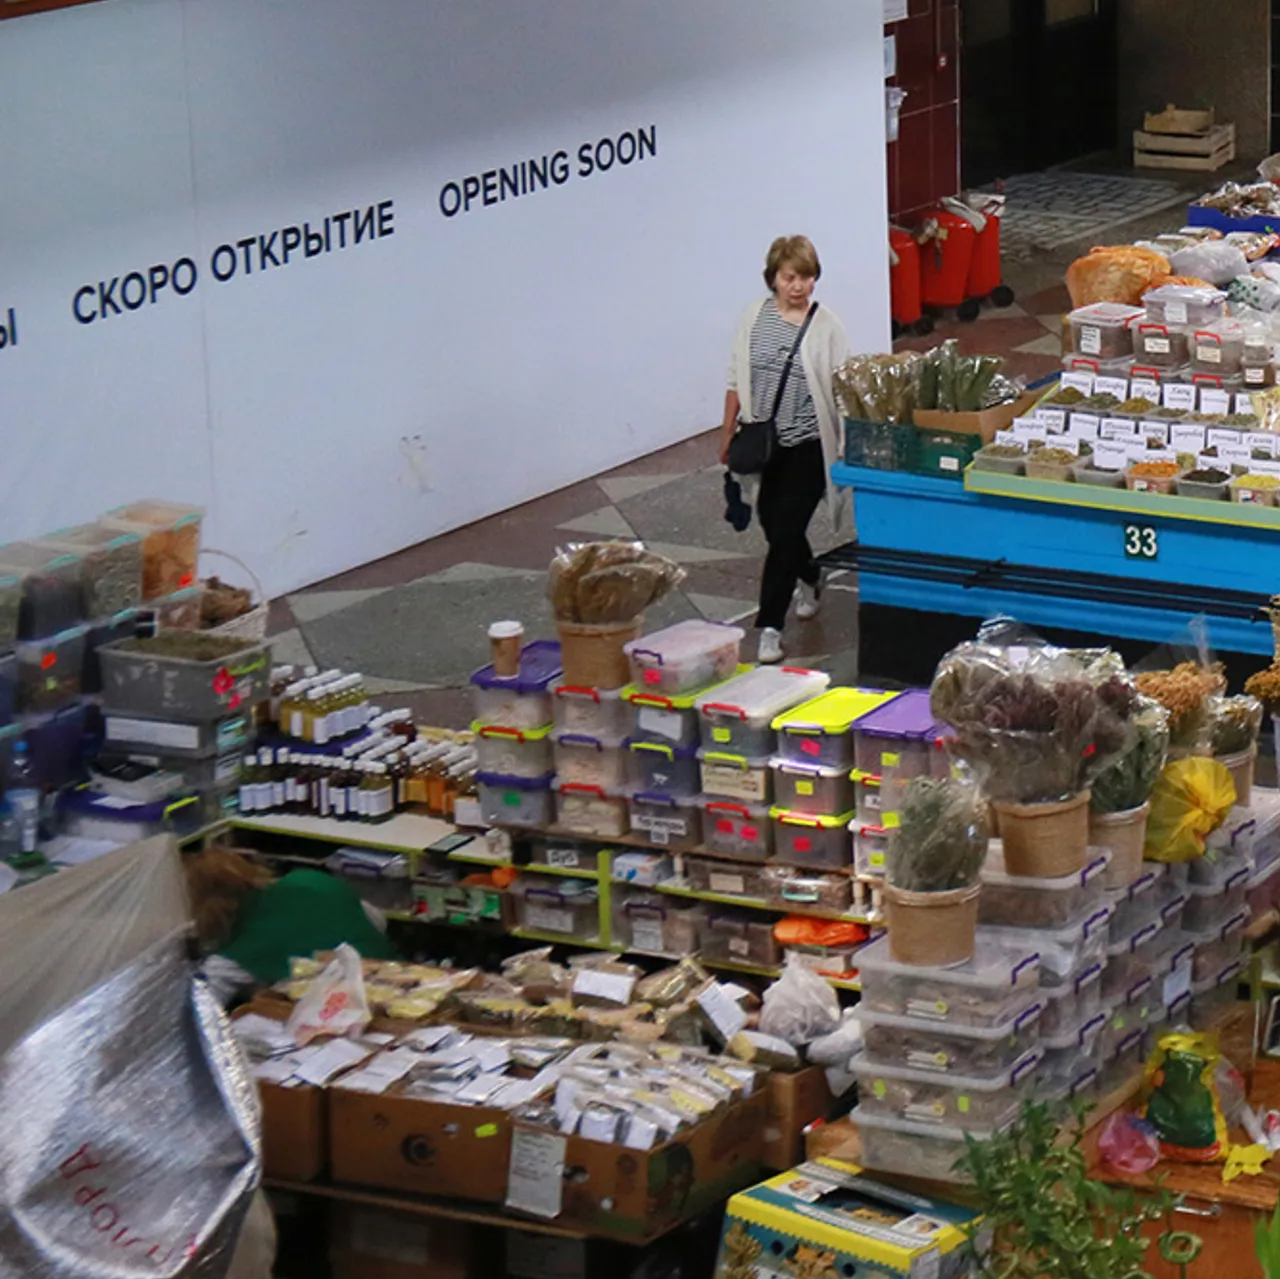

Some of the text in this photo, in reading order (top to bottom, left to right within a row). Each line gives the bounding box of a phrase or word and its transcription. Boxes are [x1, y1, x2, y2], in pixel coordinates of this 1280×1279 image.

[72, 257, 198, 324] СКОРО
[210, 200, 395, 282] ОТКРЫТИЕ
[439, 151, 569, 218] OPENING
[577, 124, 657, 178] SOON
[1125, 526, 1157, 556] 33
